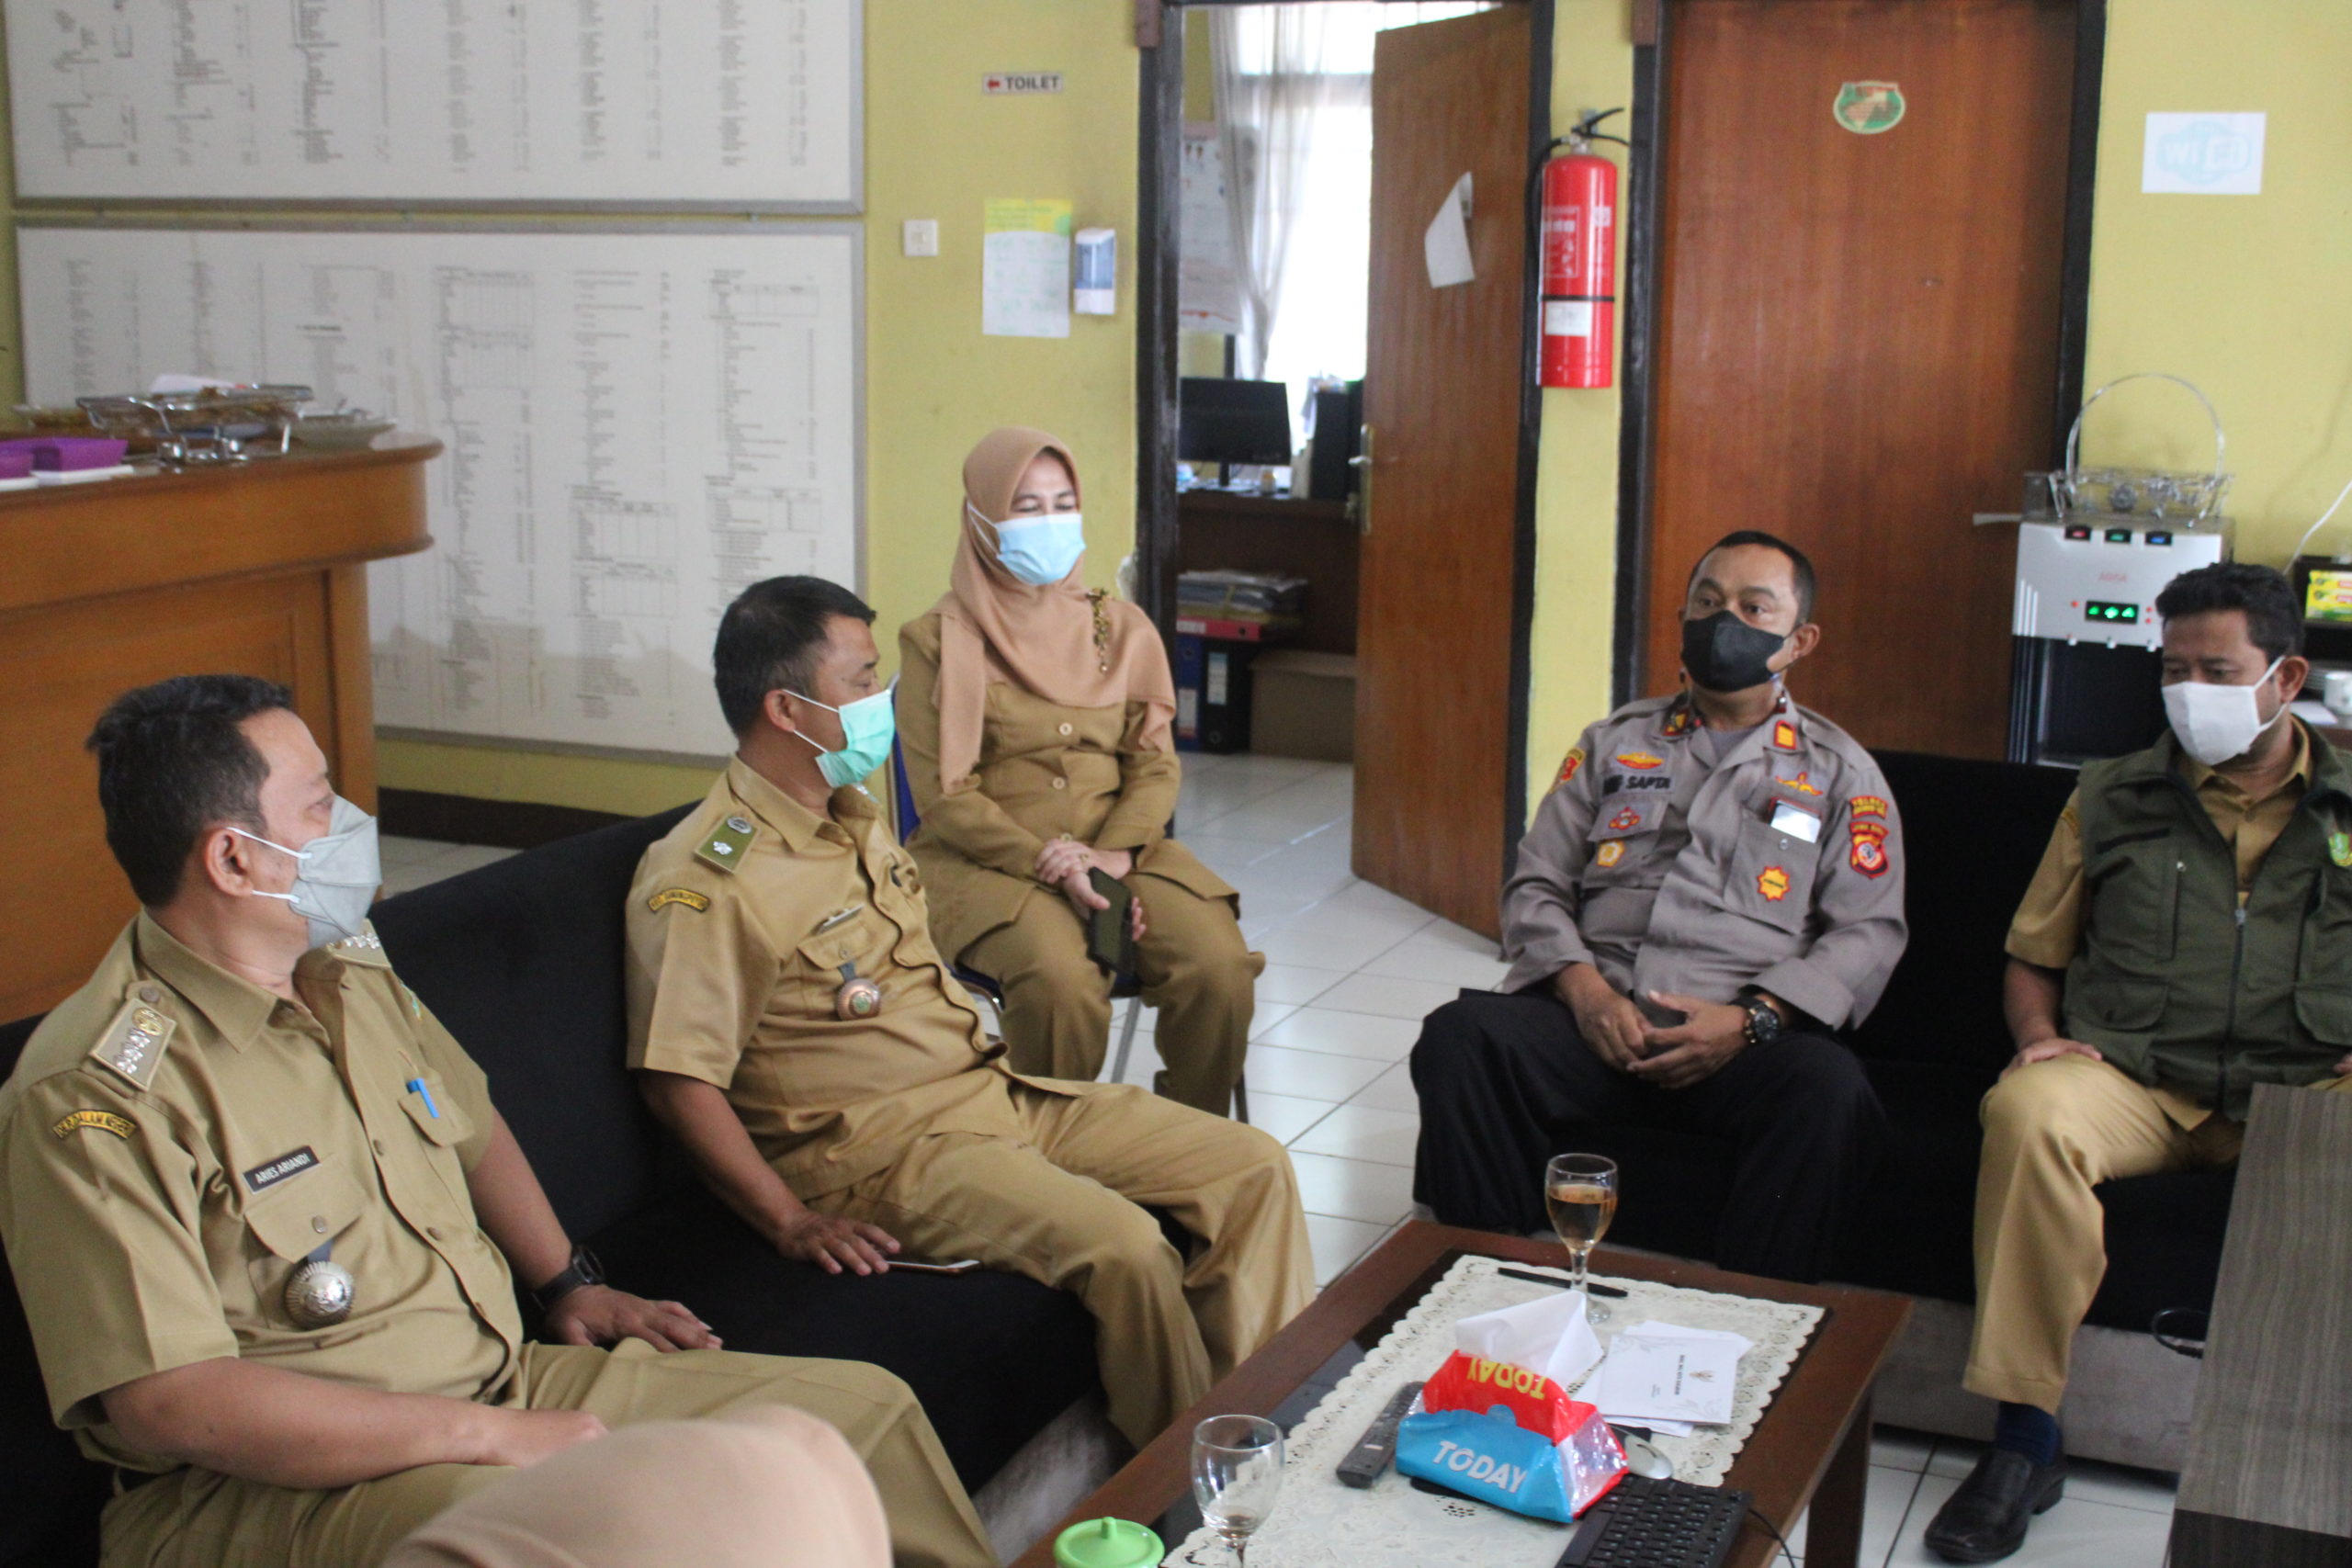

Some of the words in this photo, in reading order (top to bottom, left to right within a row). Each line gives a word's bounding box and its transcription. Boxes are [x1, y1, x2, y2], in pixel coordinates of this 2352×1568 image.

[1004, 75, 1059, 90] TOILET
[254, 1166, 279, 1184] ARIES
[1433, 1440, 1529, 1494] TODAY
